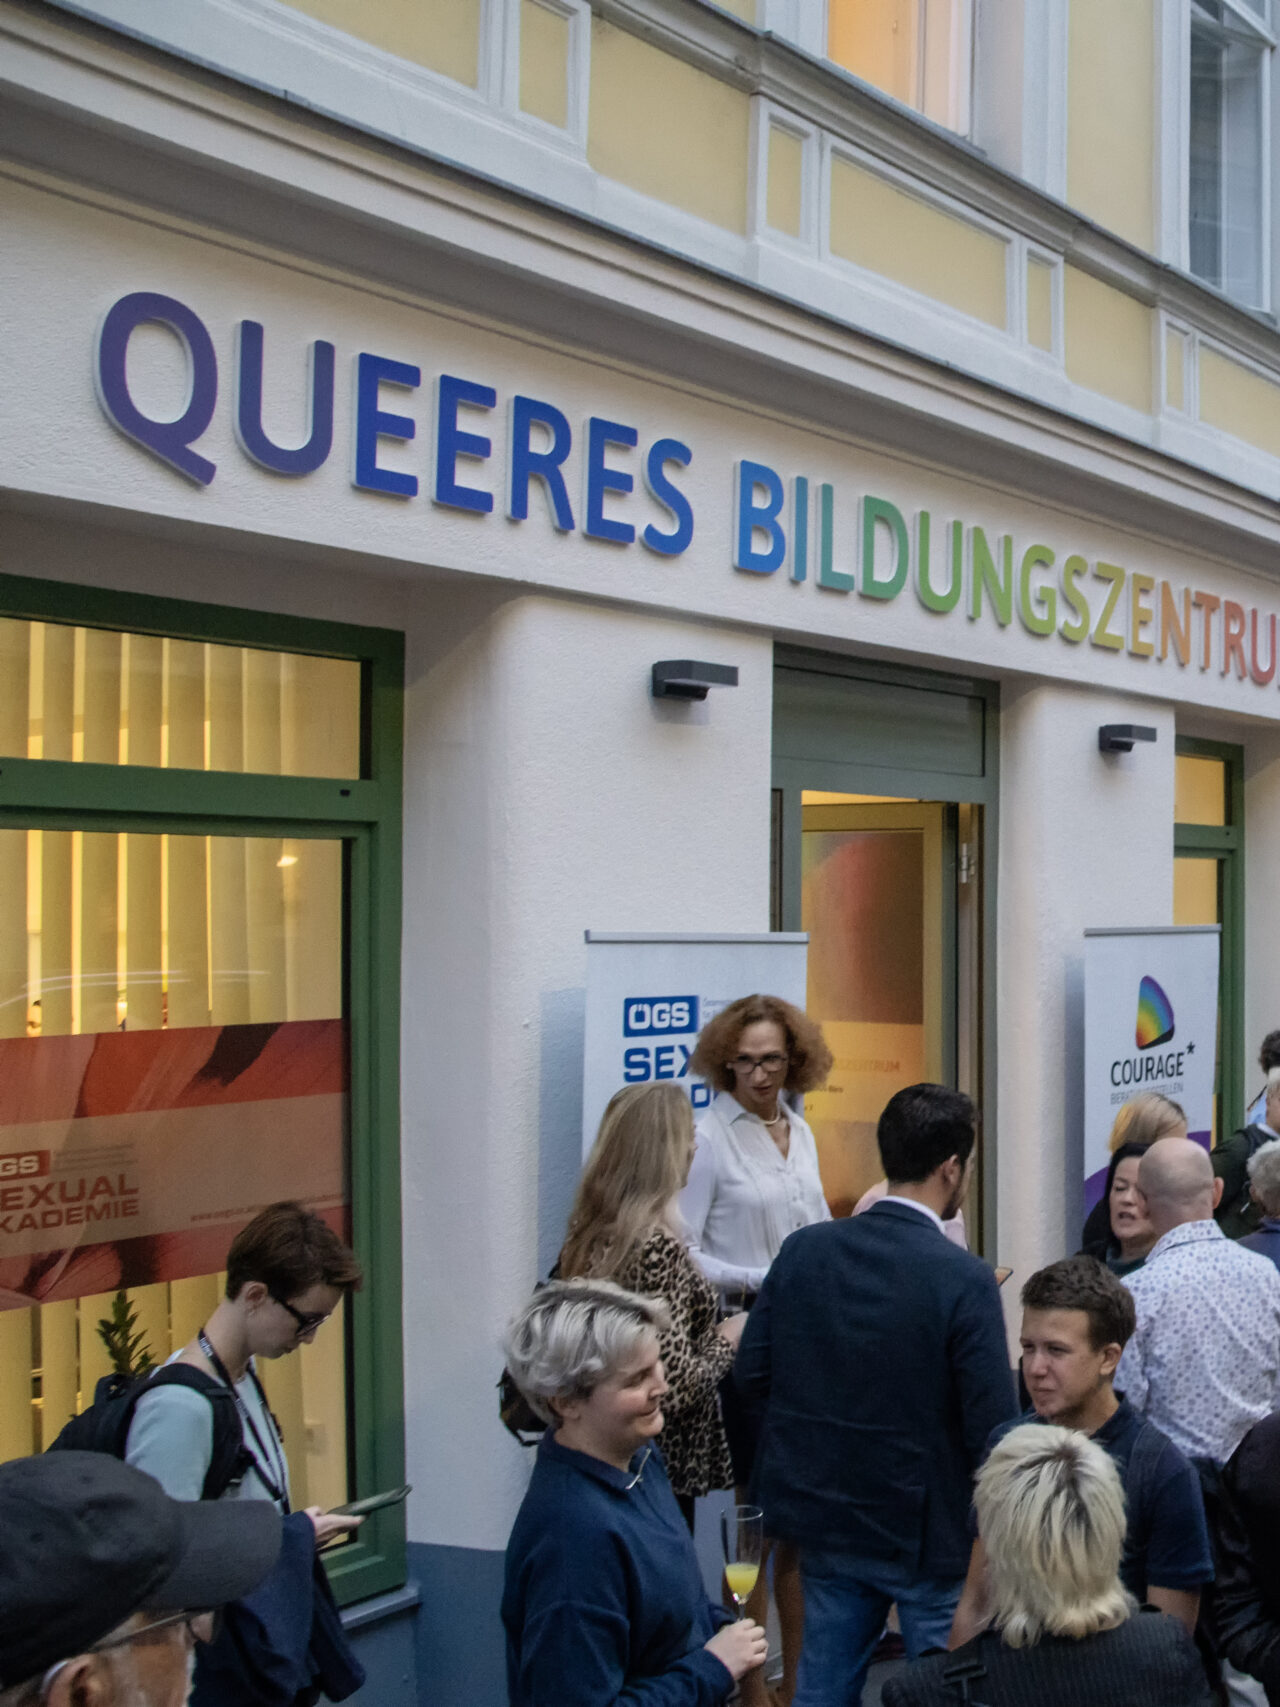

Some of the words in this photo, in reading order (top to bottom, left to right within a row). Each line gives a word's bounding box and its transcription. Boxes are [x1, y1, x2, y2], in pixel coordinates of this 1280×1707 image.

[98, 291, 694, 557] QUEERES
[628, 1002, 690, 1030] ÖGS
[624, 1045, 692, 1082] SEX
